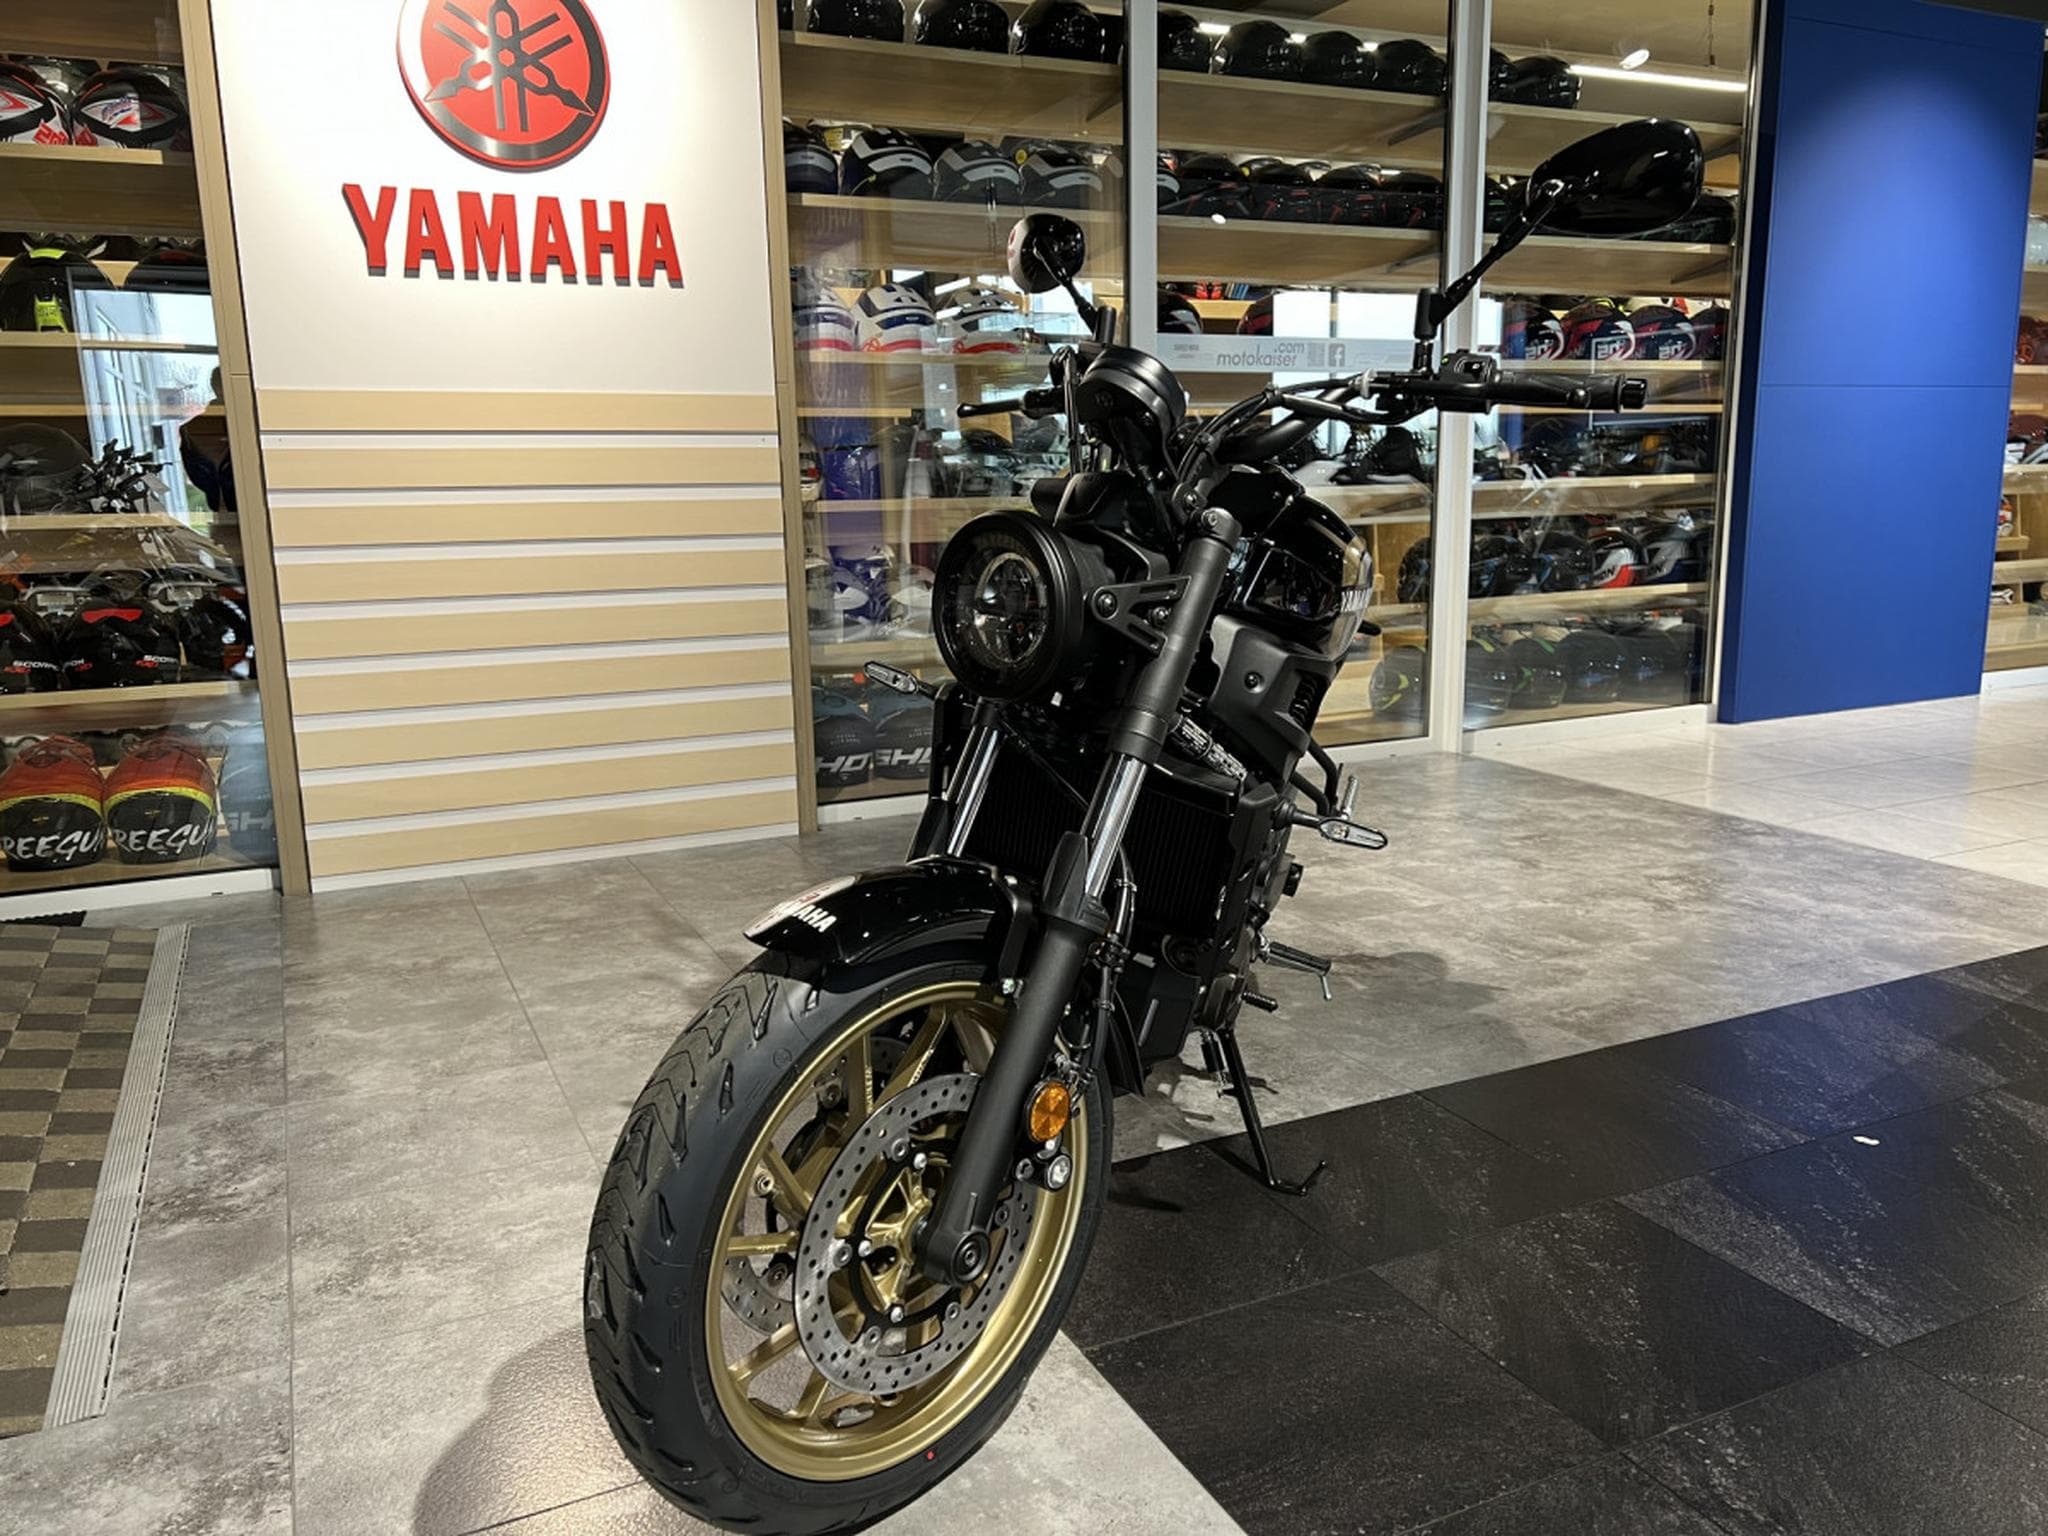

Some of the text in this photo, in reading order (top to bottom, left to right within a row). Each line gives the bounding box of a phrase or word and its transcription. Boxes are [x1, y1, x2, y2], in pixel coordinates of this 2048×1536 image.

[342, 183, 683, 288] YAMAHA
[1216, 344, 1298, 367] motokaiser
[1273, 342, 1305, 354] .com
